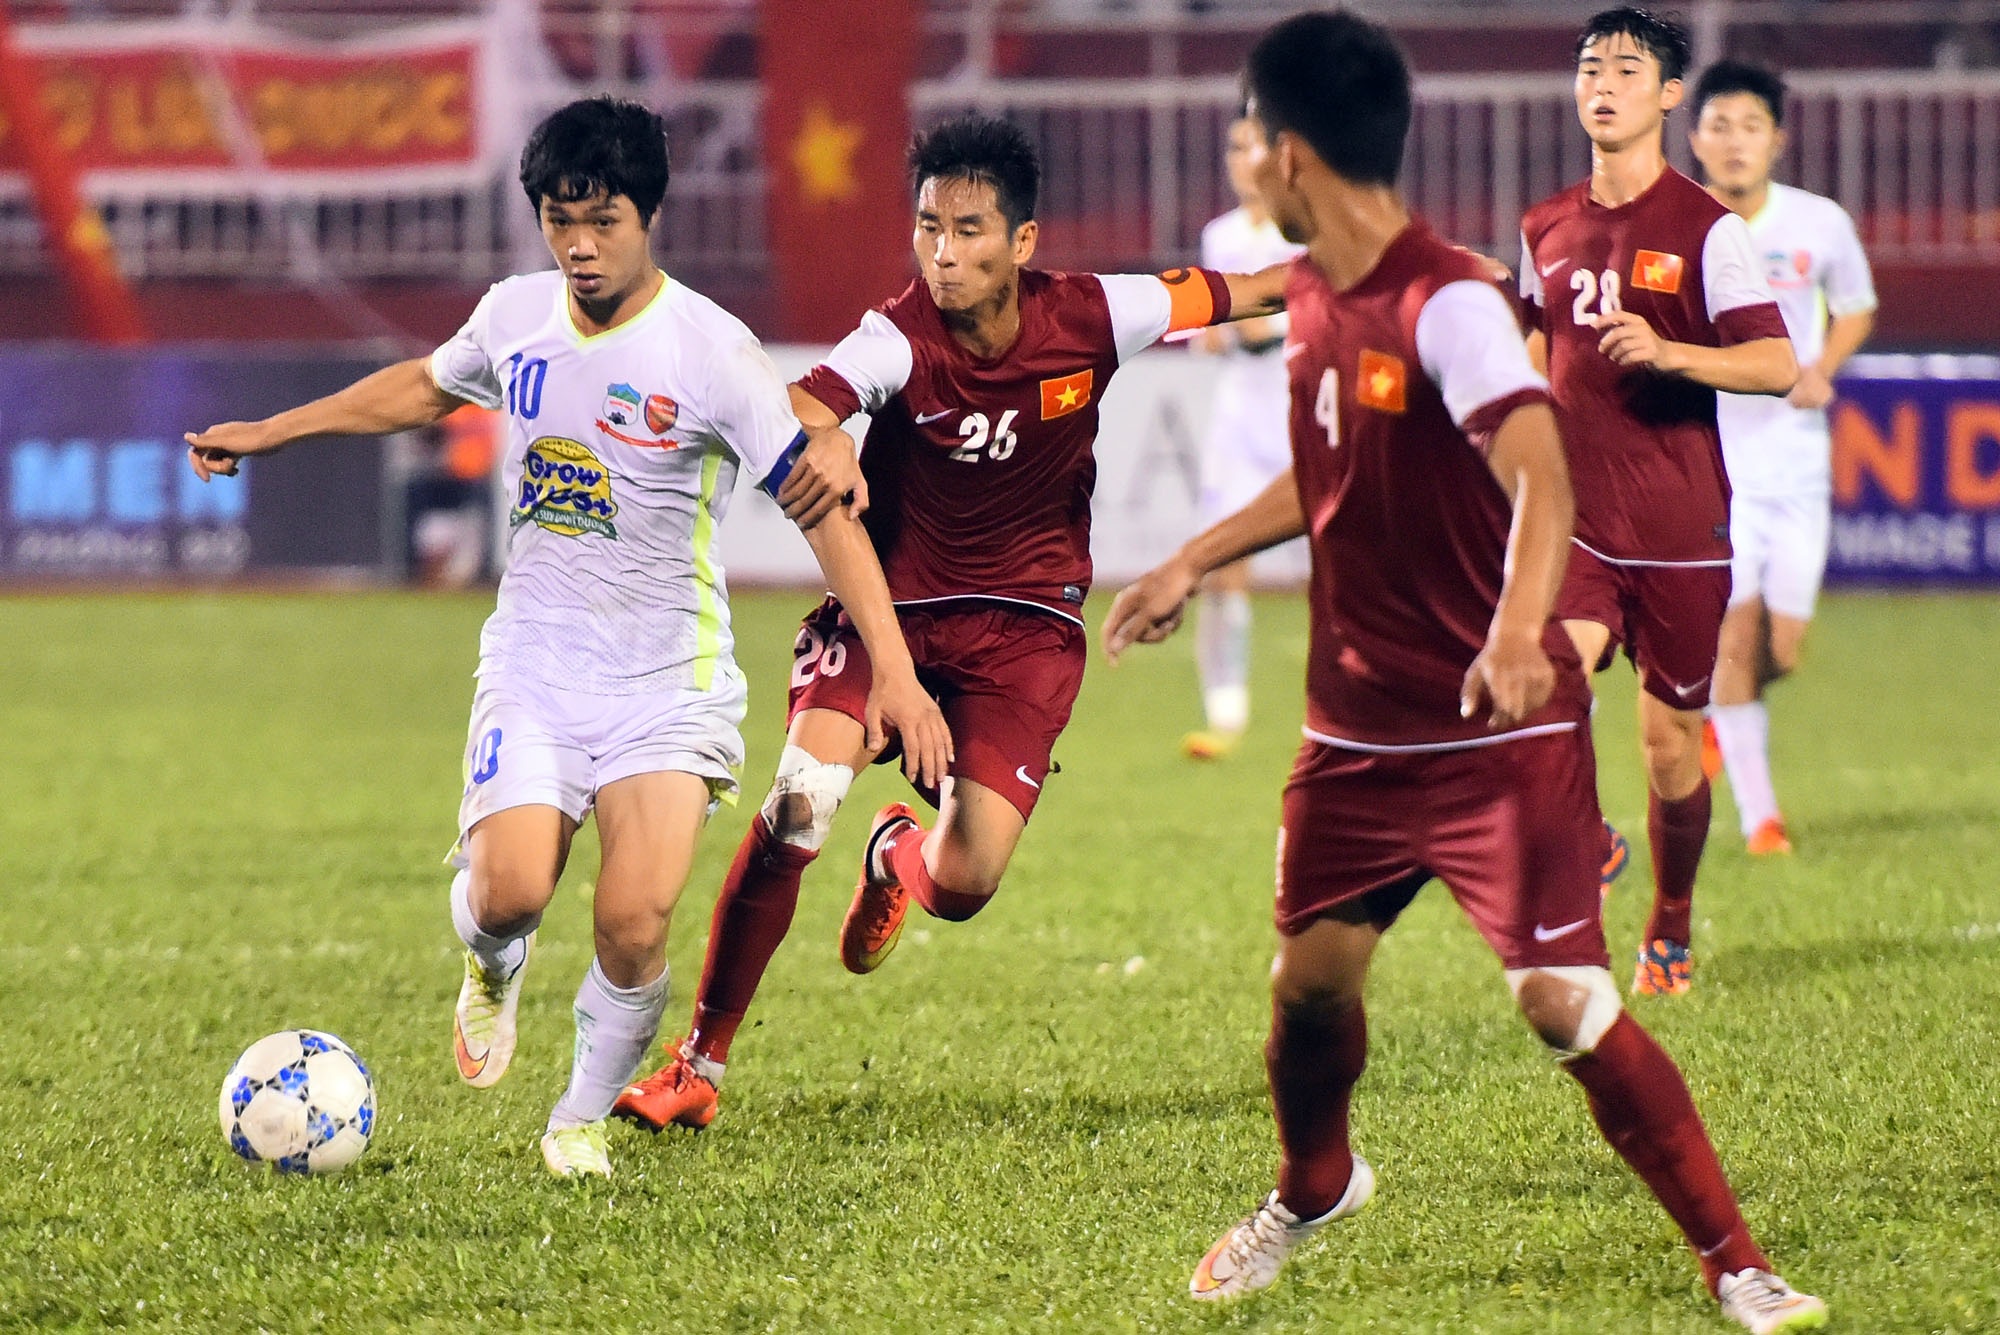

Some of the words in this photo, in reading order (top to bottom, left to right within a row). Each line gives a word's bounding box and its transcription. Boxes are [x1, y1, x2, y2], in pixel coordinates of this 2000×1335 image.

[1570, 268, 1622, 326] 28
[508, 352, 548, 420] 10
[1314, 367, 1340, 450] 4
[948, 409, 1020, 463] 26
[526, 451, 602, 488] Grow
[791, 627, 847, 689] 26
